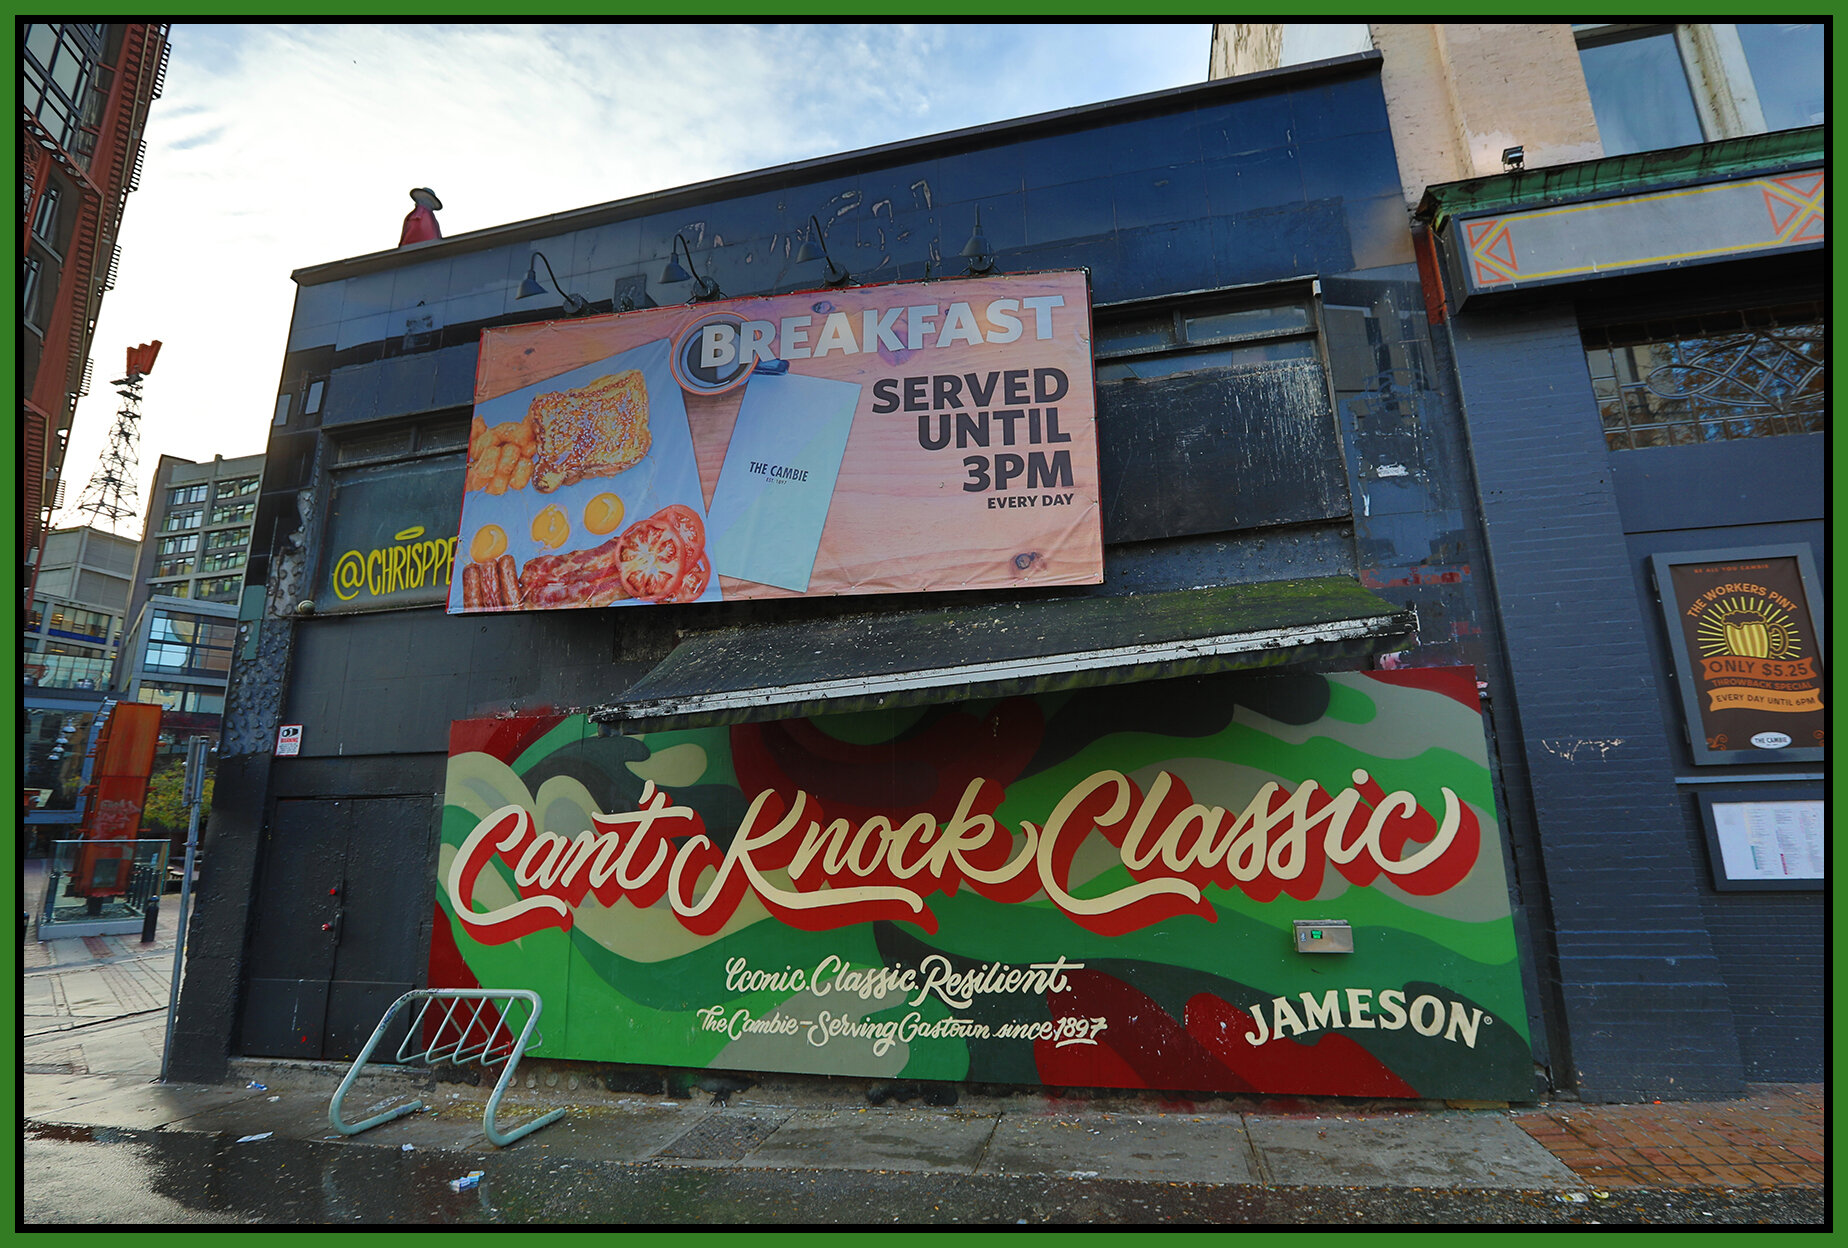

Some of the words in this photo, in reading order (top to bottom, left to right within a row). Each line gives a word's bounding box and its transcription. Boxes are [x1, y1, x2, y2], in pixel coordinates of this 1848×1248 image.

[700, 295, 1065, 368] BREAKFAST
[872, 367, 1069, 414] SERVED
[918, 407, 1072, 451] UNTIL
[749, 461, 768, 475] THE
[770, 465, 809, 482] CAMBIE
[962, 450, 1074, 492] 3PM
[987, 495, 1038, 509] EVERY
[1042, 493, 1074, 506] DAY
[1687, 599, 1708, 617] THE
[1702, 582, 1767, 602] WORKERS
[1768, 591, 1798, 612] PINT
[1709, 660, 1755, 673] ONLY
[1761, 663, 1808, 677] $5.25
[1711, 679, 1773, 690] THROWBACK
[1774, 682, 1813, 691] SPECIAL
[1715, 694, 1744, 703] EVERY
[1747, 694, 1765, 703] DAY
[1767, 697, 1793, 706] UNTIL
[1795, 697, 1816, 706] 6PM
[667, 776, 1038, 917] Knock
[1036, 768, 1461, 916] Classic
[908, 954, 1085, 1010] Resilient.
[696, 1005, 728, 1033] The
[898, 1012, 991, 1043] Gastown
[992, 1019, 1053, 1041] since
[1053, 1016, 1108, 1049] 1897
[1244, 988, 1484, 1049] JAMESON
